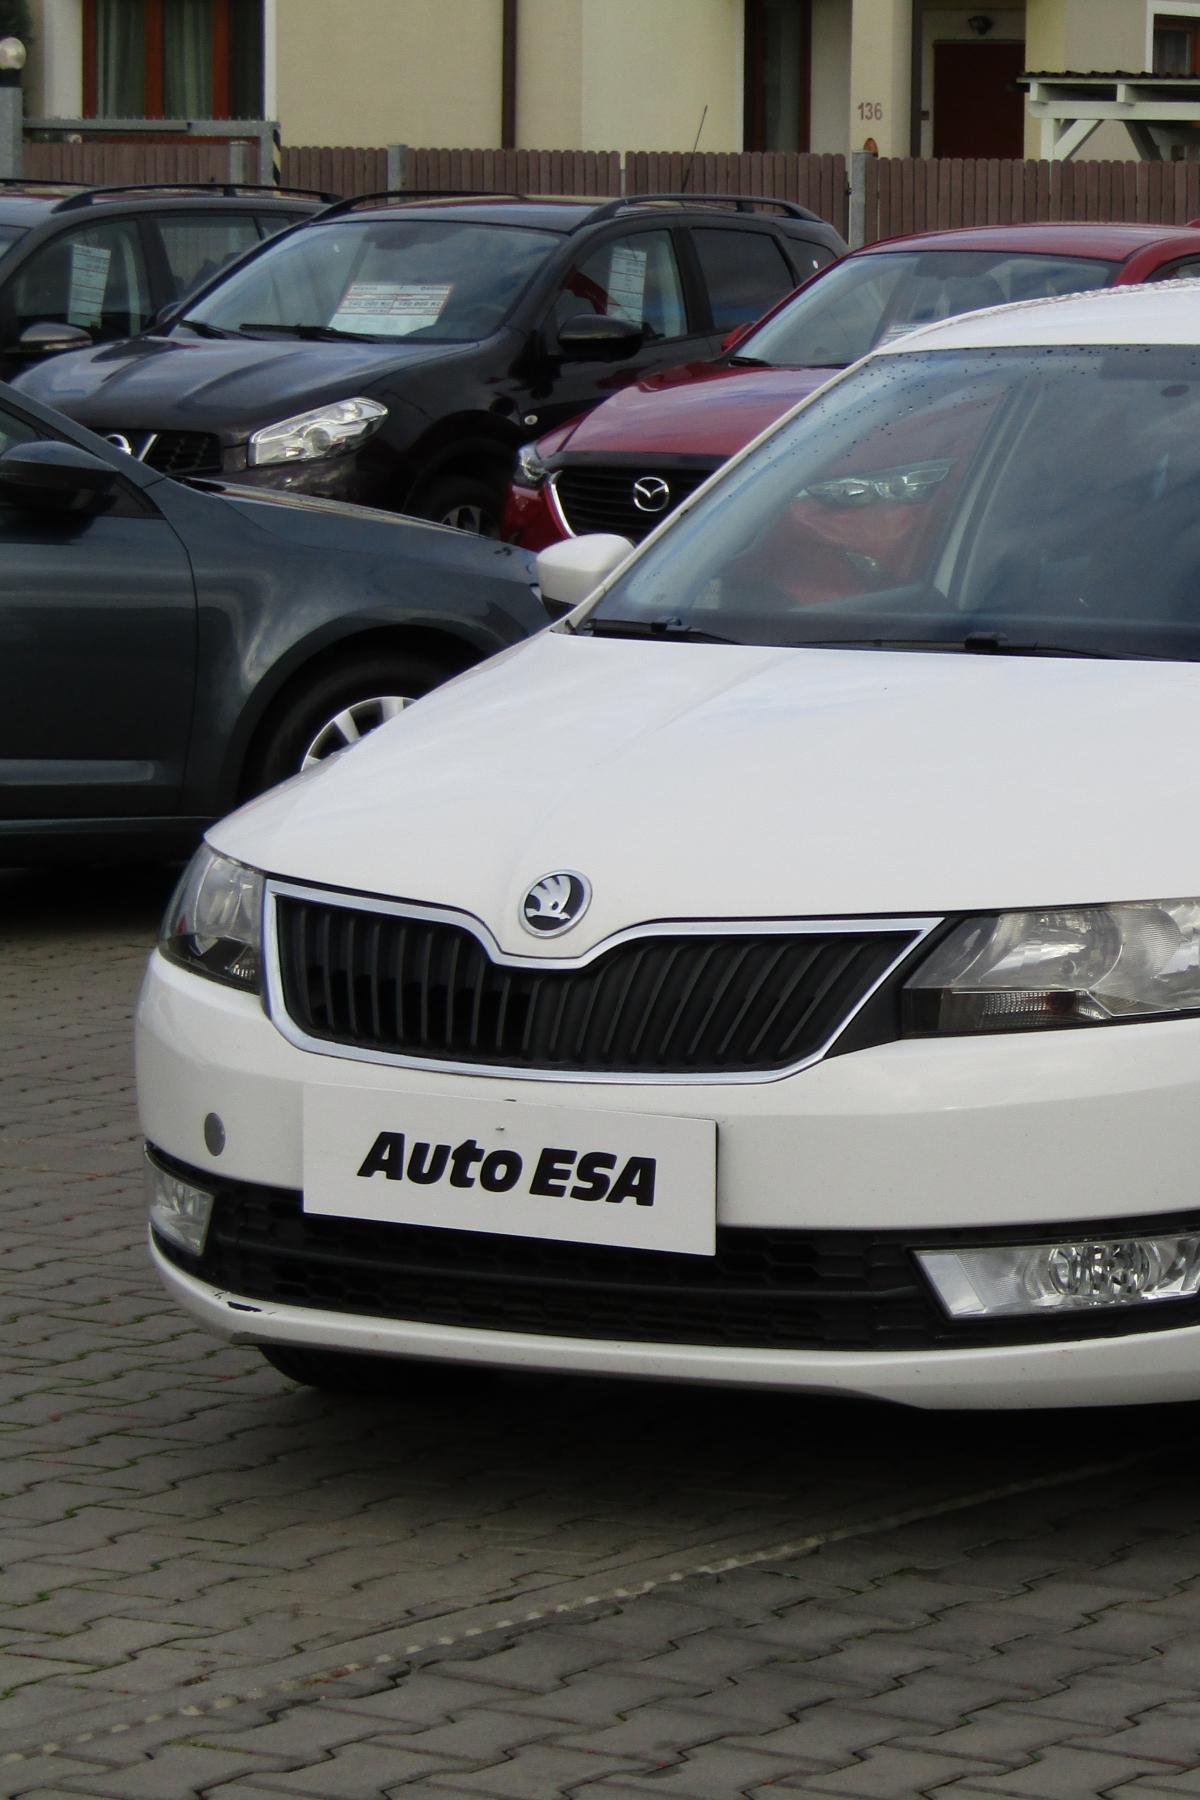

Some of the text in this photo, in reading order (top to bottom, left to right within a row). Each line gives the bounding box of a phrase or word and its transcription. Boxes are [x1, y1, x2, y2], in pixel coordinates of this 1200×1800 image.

[857, 101, 884, 121] 136
[356, 1131, 657, 1207] Auto ESA
